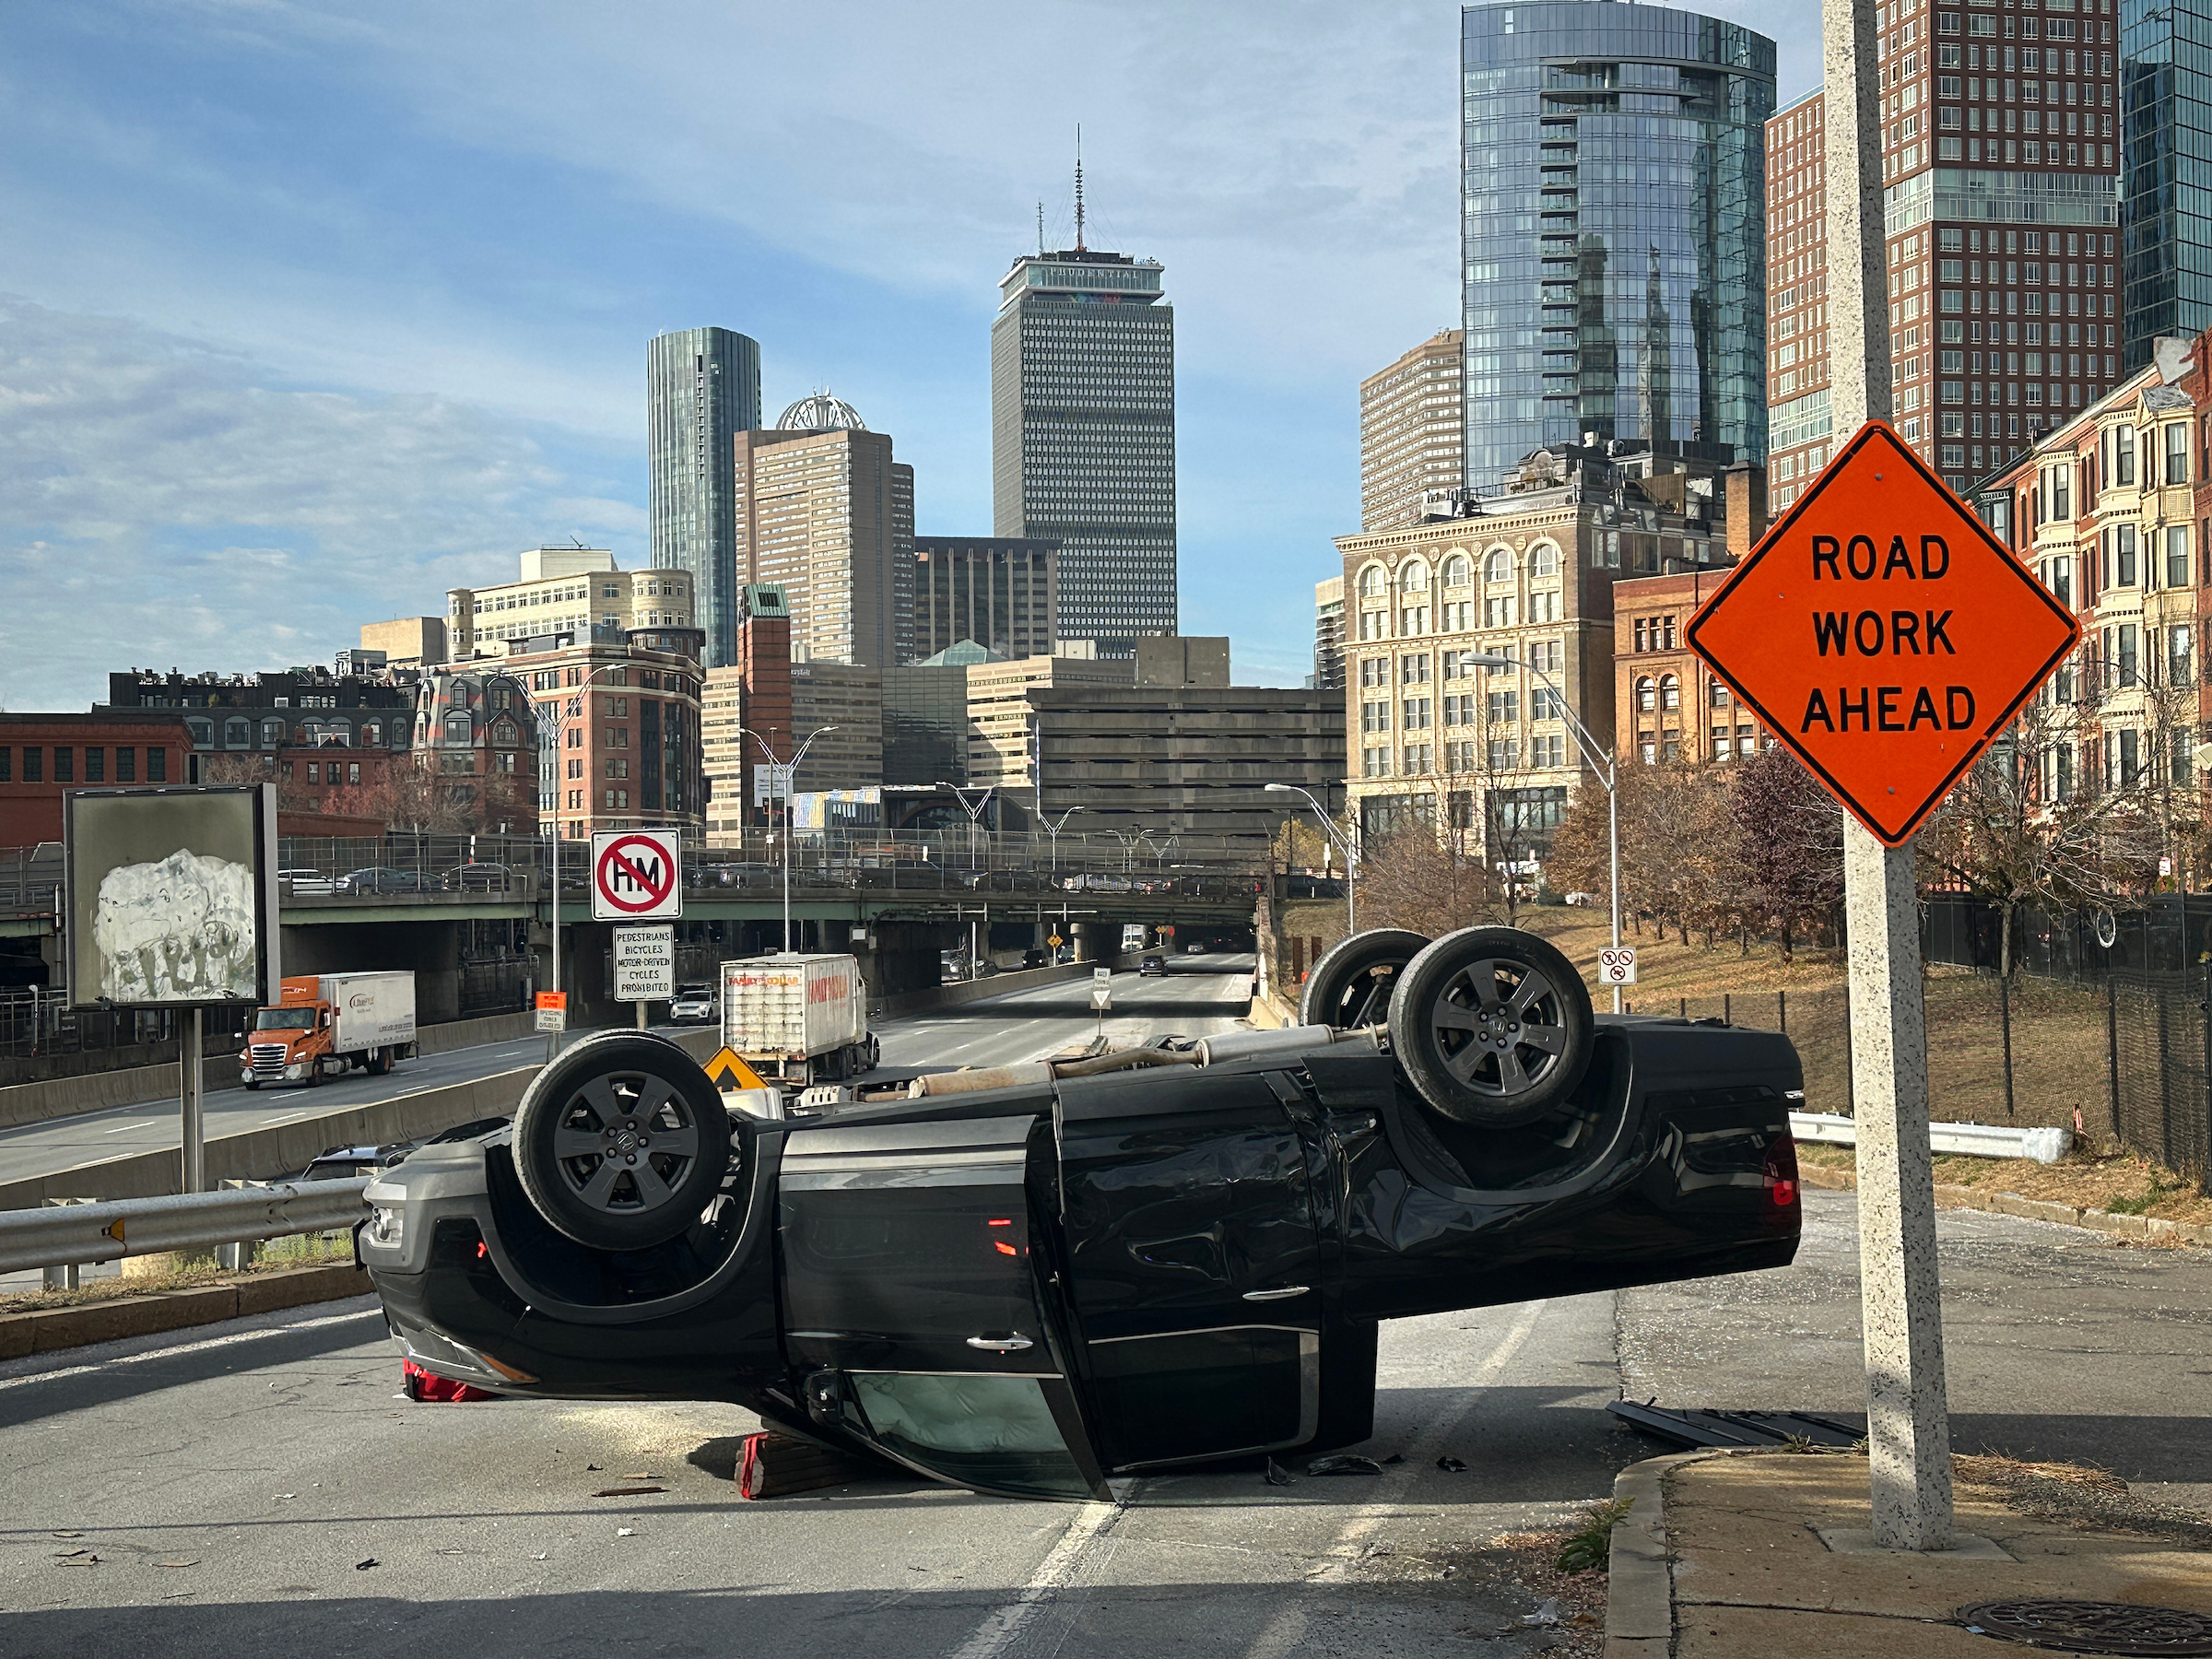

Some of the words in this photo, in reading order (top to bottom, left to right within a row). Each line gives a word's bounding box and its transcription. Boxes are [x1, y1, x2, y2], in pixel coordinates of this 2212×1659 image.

[1812, 535, 1950, 581] ROAD
[1812, 609, 1957, 657] WORK
[1800, 686, 1976, 734] AHEAD
[618, 932, 670, 943] PEDESTRIANS
[625, 945, 663, 955] BICYCLES
[629, 971, 660, 980] CYCLES
[621, 982, 669, 993] PROHIBITED
